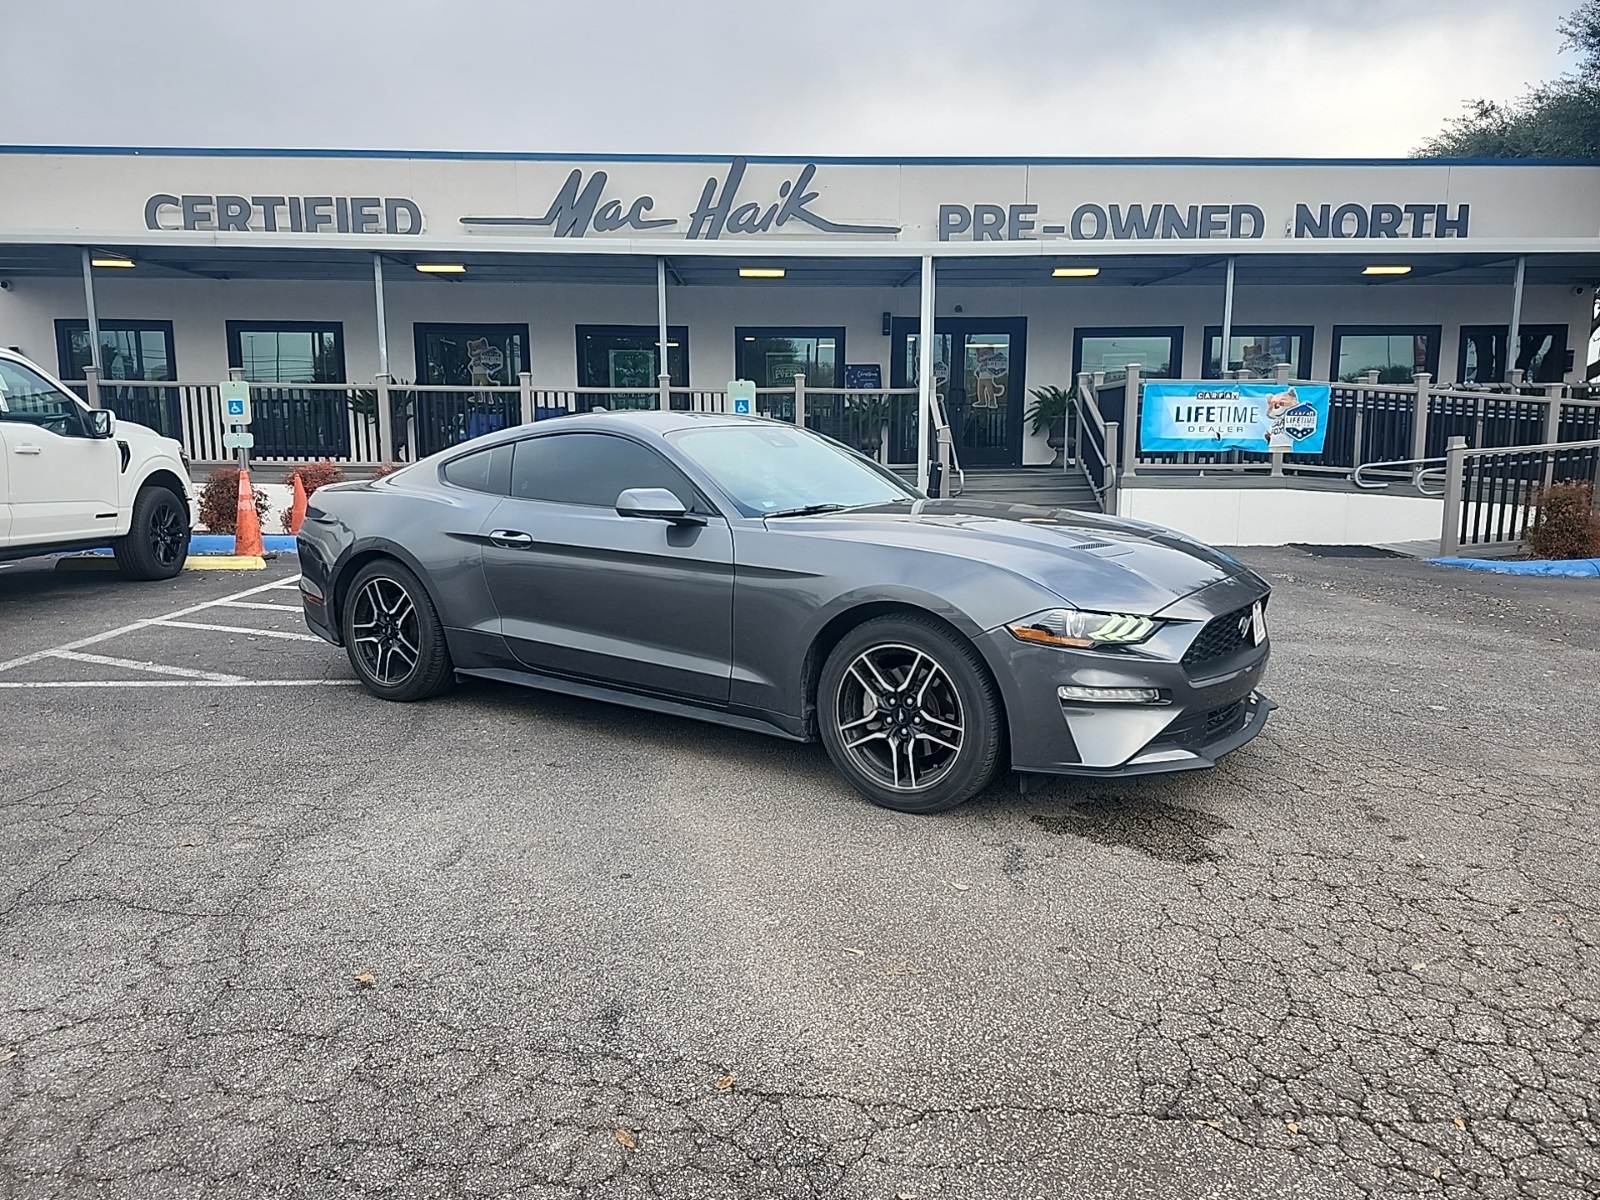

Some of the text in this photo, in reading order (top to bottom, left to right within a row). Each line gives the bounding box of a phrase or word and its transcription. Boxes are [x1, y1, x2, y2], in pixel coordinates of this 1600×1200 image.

[459, 156, 902, 240] Mac Haik
[145, 194, 423, 235] CERTIFIED
[937, 203, 1471, 241] PRE-OWNED NORTH
[1196, 391, 1240, 400] CARFAX
[1174, 405, 1259, 424] LIFETIME
[1187, 425, 1244, 433] DEALER
